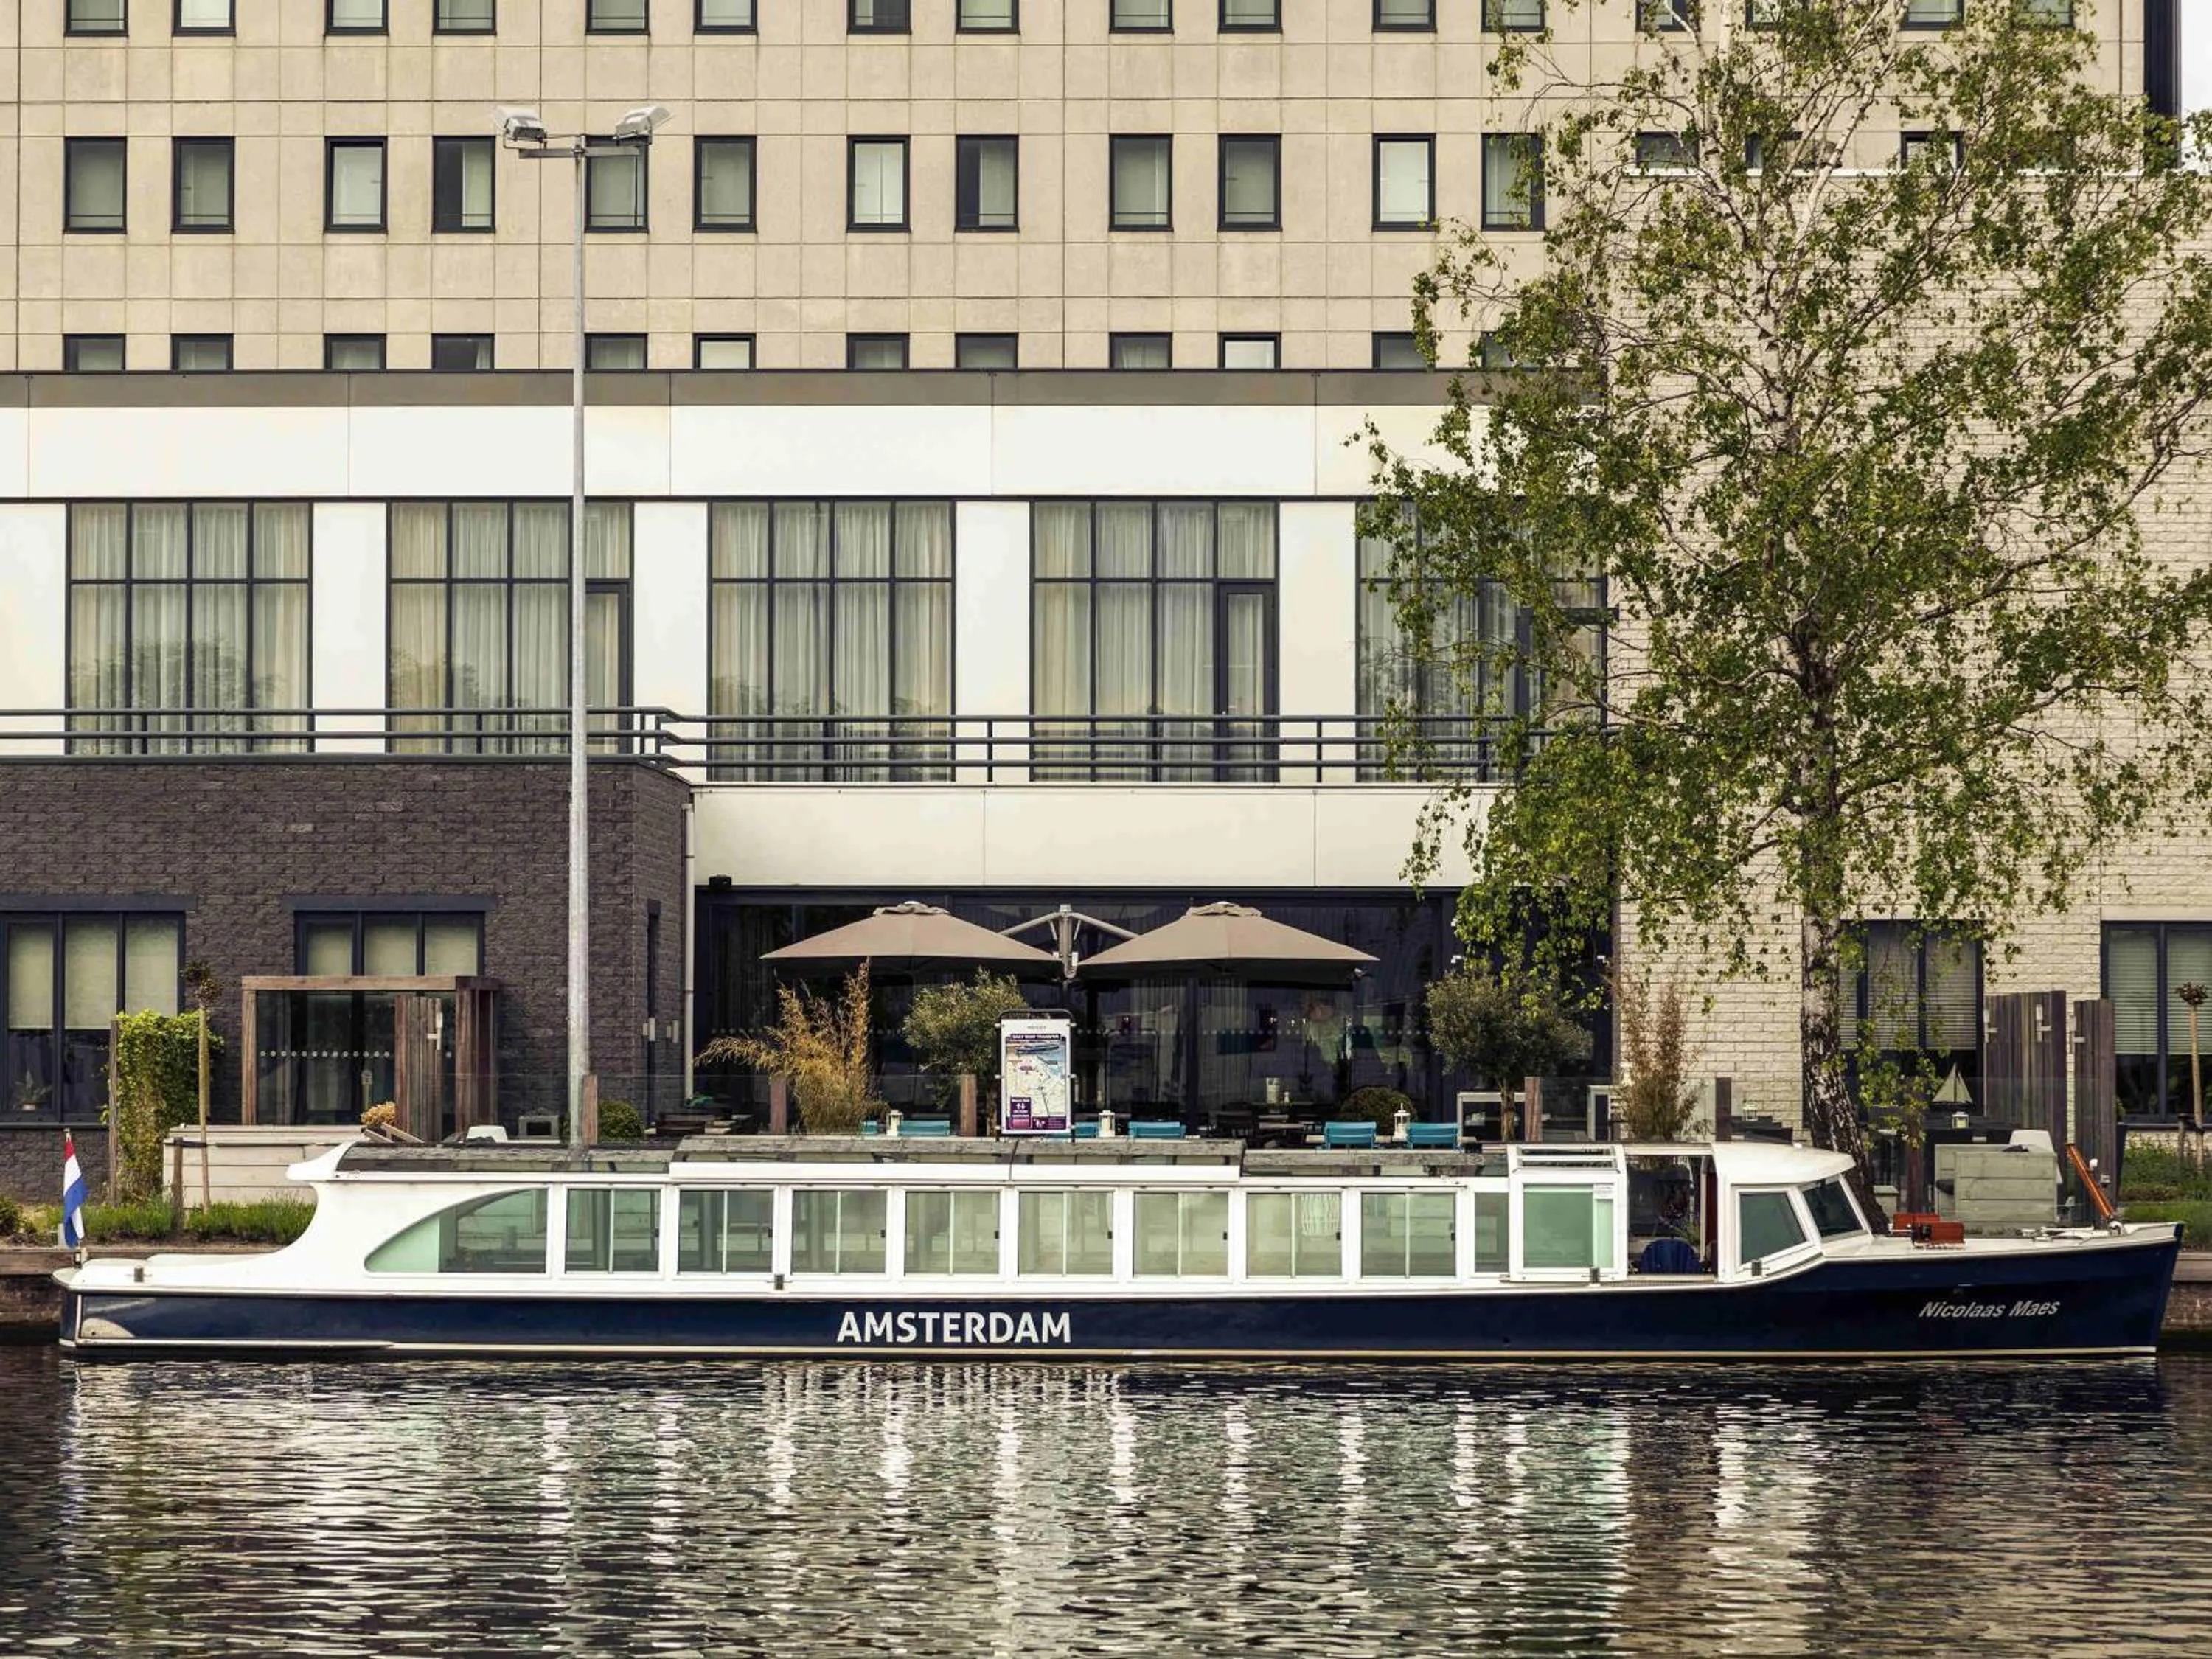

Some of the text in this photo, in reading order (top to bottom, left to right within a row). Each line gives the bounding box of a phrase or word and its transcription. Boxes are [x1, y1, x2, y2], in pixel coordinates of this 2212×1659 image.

[1919, 1300, 2061, 1318] Nicolaas Maes
[837, 1312, 1071, 1343] AMSTERDAM
